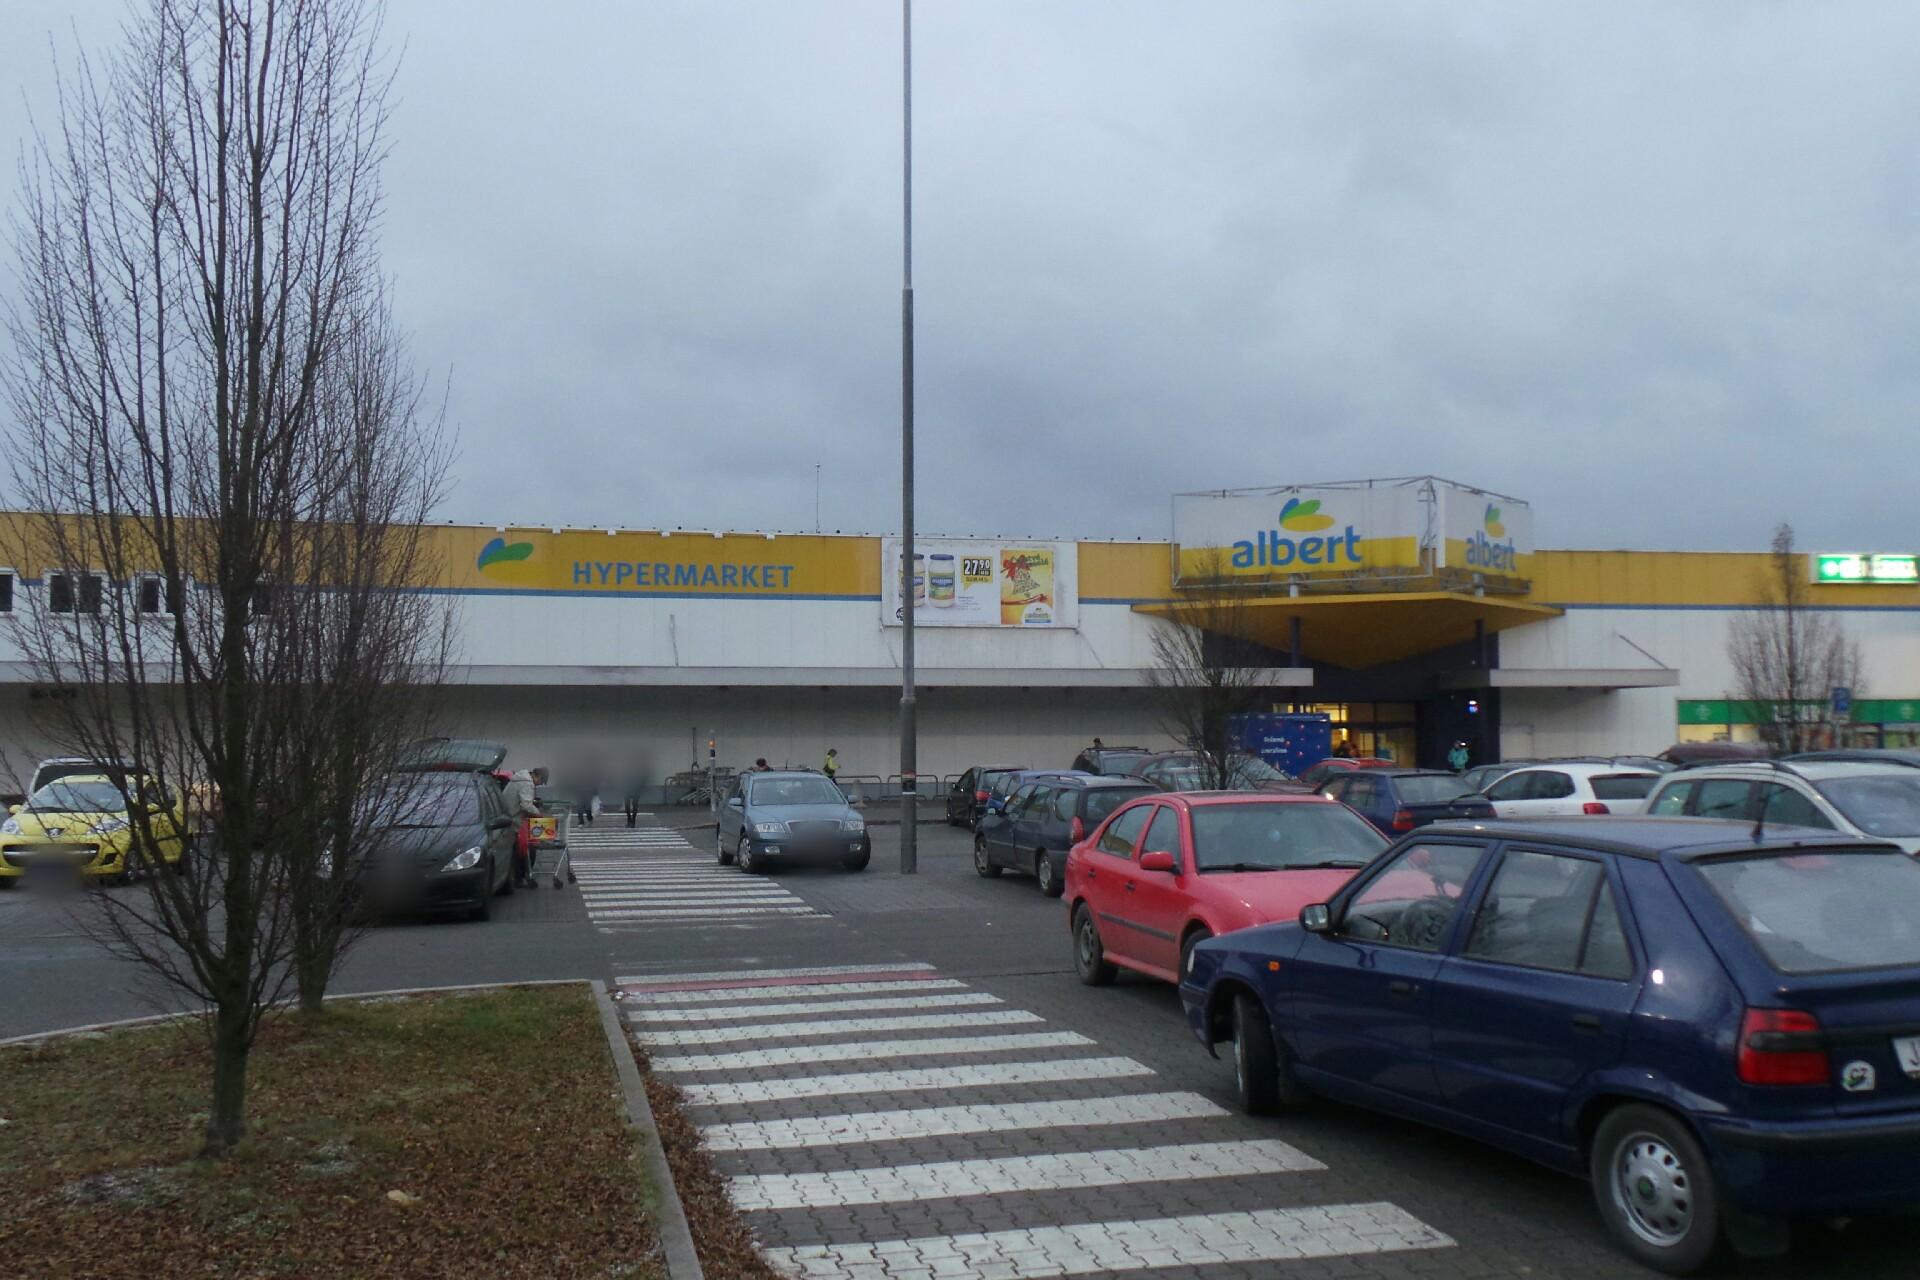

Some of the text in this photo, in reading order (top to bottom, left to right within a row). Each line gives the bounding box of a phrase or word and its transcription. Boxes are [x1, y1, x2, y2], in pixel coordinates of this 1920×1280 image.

[1232, 525, 1362, 568] albert
[1466, 531, 1517, 571] albert
[573, 561, 794, 588] HYPERMARKET
